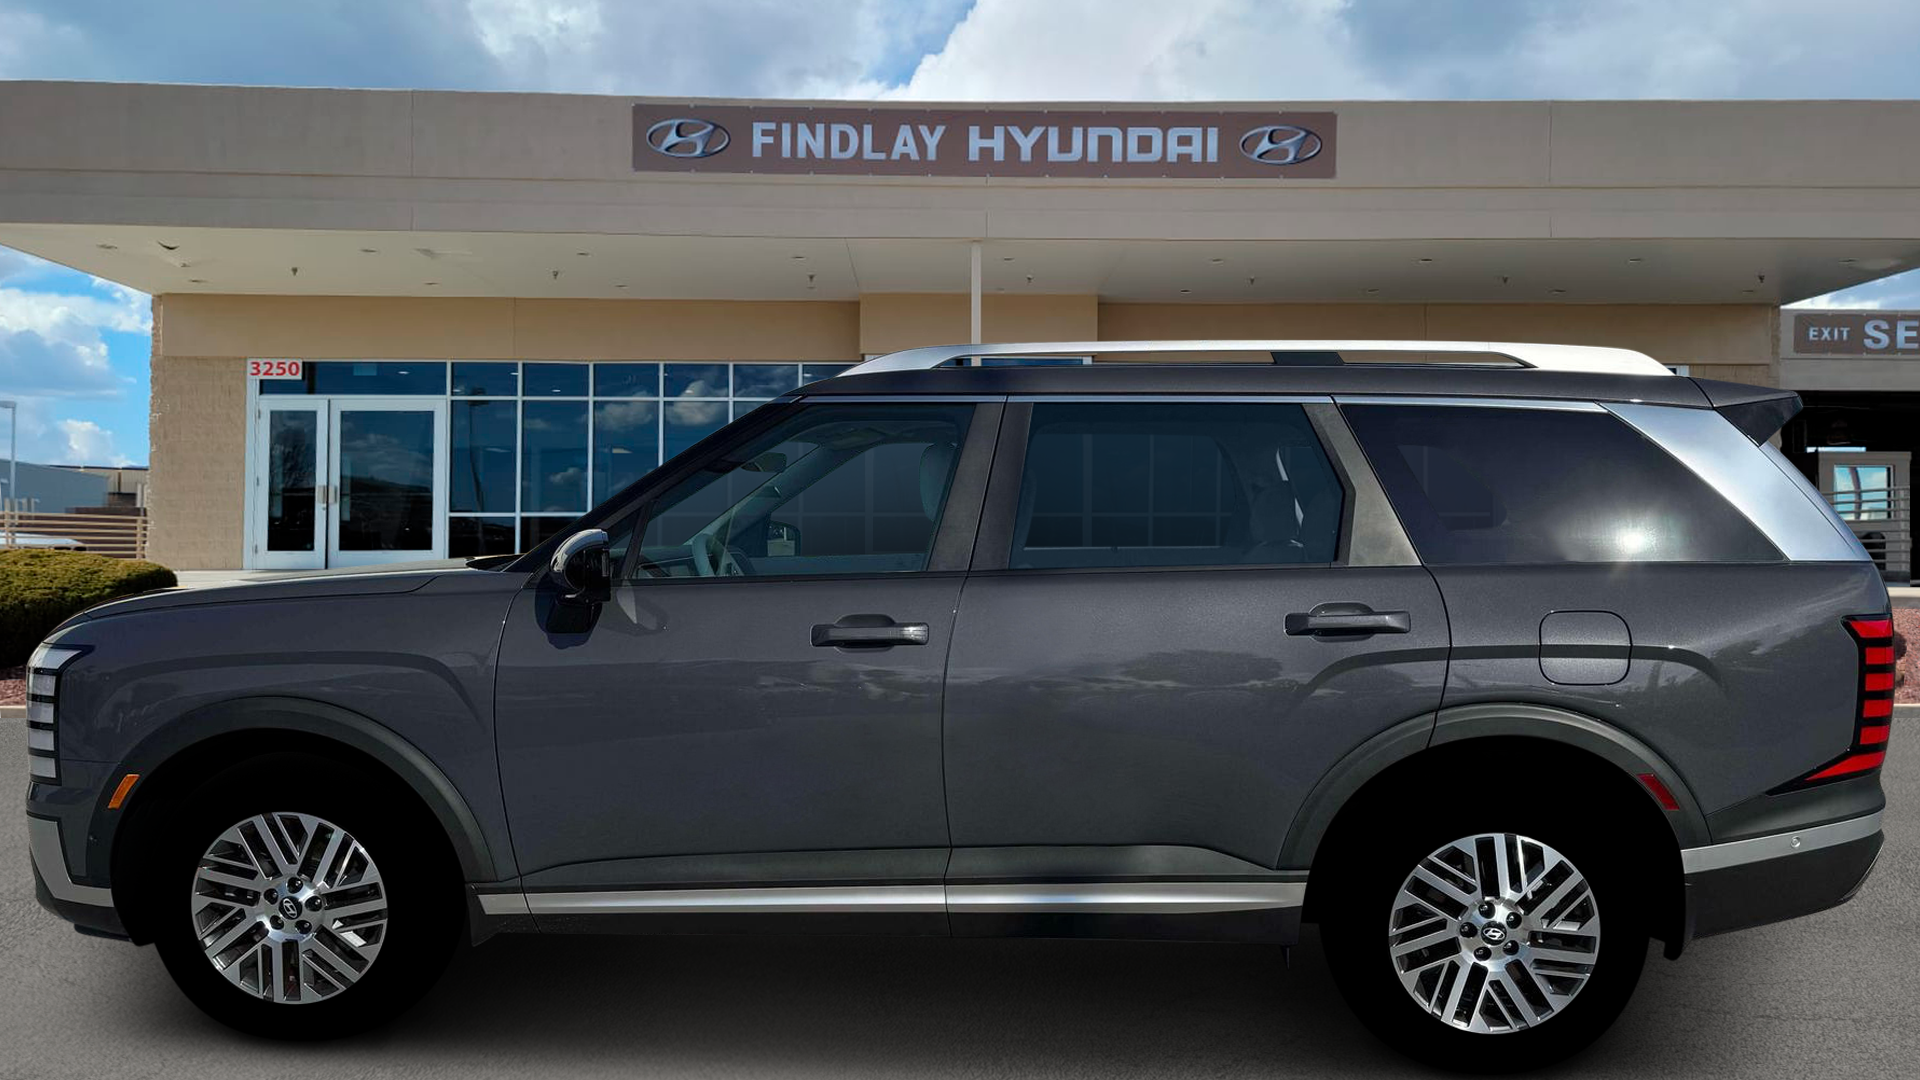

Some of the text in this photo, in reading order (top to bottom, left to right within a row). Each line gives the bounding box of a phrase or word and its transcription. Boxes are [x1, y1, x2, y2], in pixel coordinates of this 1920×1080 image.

[752, 121, 1219, 163] FINDLAY HYUNDAI
[1808, 319, 1920, 350] EXIT SE
[249, 361, 300, 376] 3250
